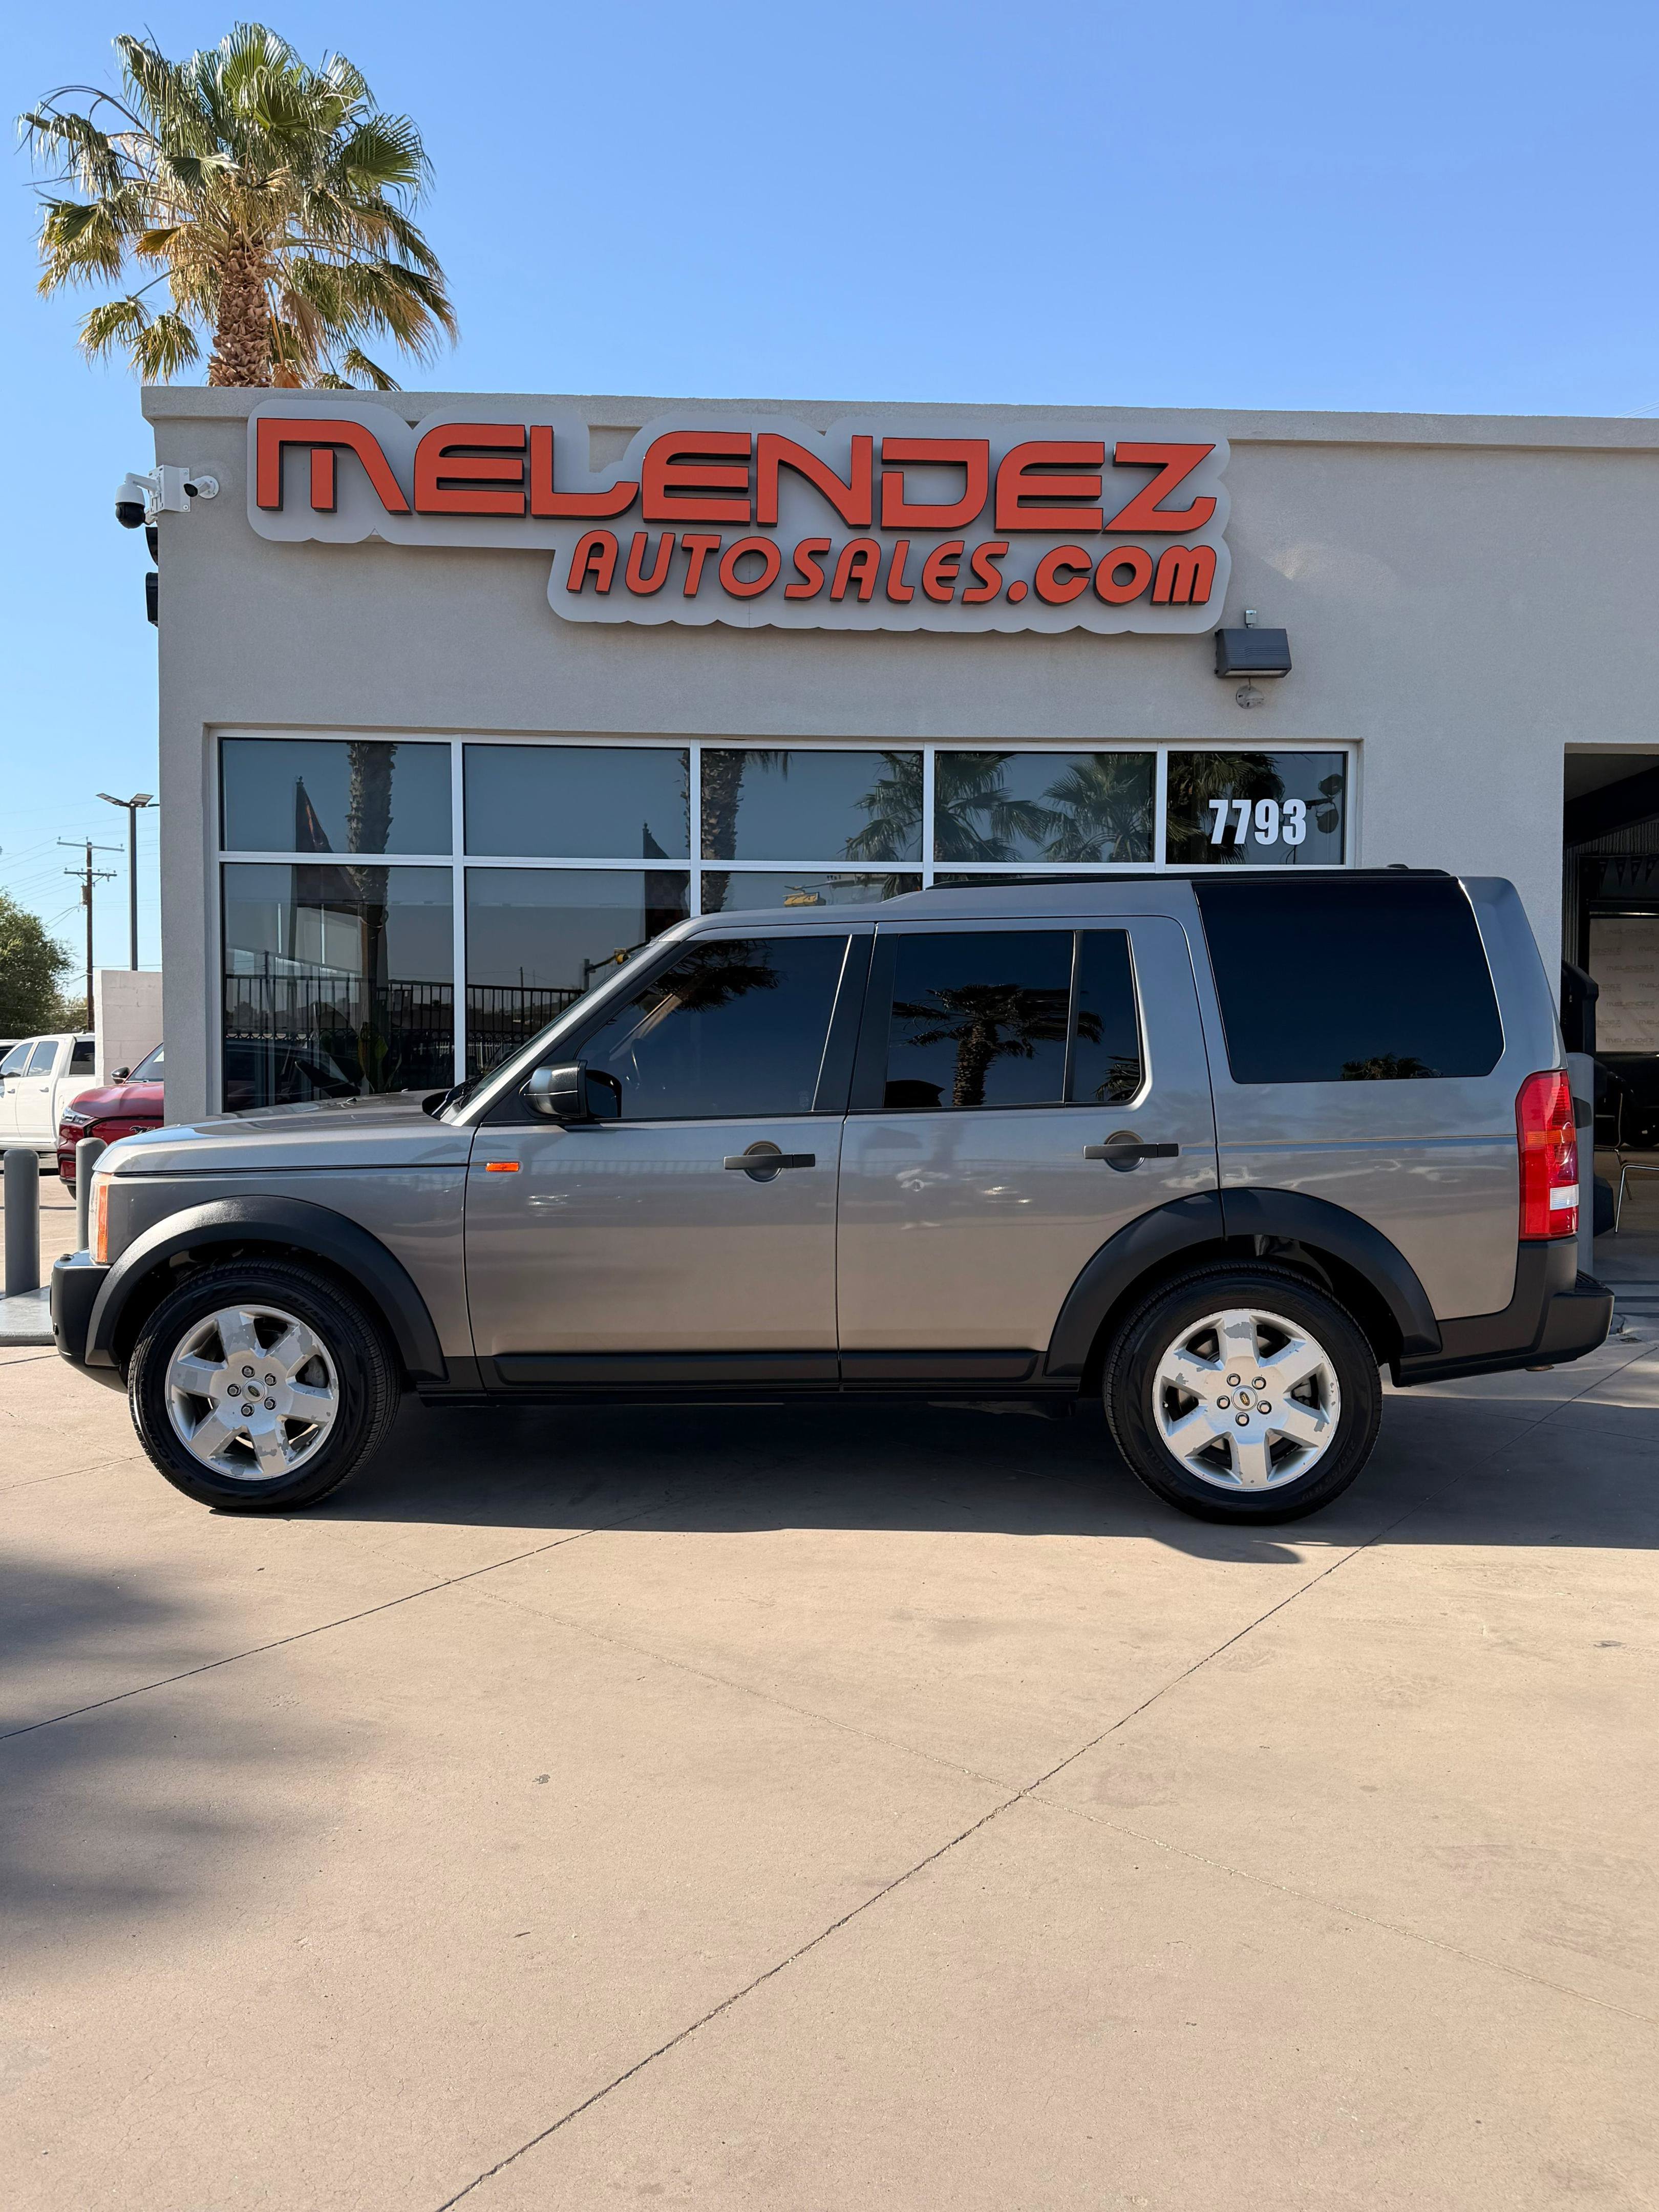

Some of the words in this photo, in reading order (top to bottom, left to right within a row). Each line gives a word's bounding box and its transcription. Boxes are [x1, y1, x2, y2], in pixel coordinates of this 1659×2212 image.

[257, 418, 1216, 534] MELENDEZ
[566, 530, 1216, 605] AUTOSALES.COM
[1209, 799, 1306, 845] 7793
